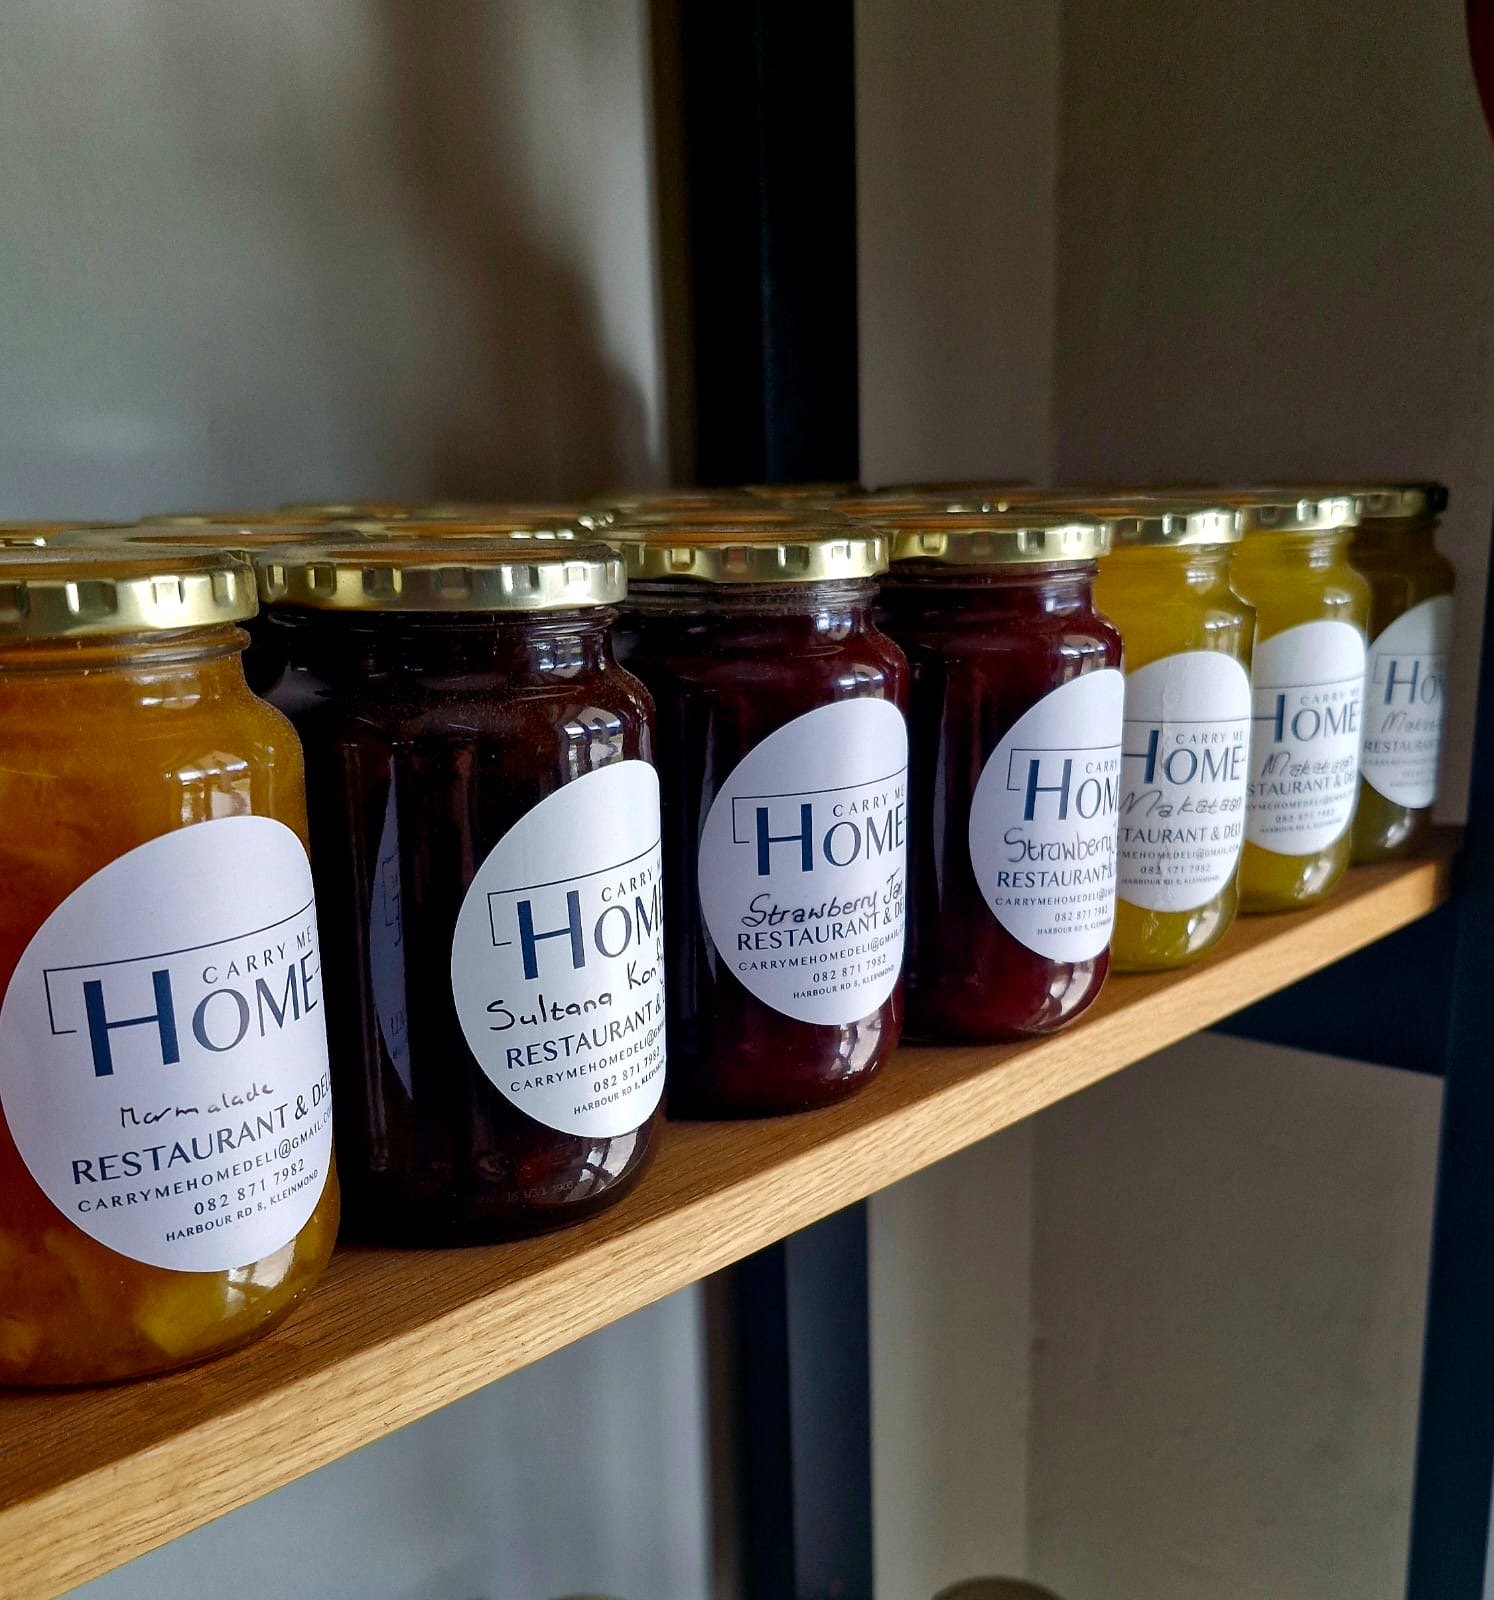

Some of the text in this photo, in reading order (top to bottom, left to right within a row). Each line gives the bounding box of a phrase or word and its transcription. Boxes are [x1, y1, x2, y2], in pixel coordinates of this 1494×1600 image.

[1300, 692, 1345, 706] CARRY
[1175, 730, 1244, 745] CARRY ME
[832, 793, 888, 818] CARRY
[1023, 759, 1119, 821] HOM
[1247, 776, 1329, 797] STAURANT
[756, 802, 905, 876] HOME
[1003, 827, 1112, 867] Strawberry
[1118, 827, 1207, 844] TAURANT
[1210, 826, 1220, 841] &
[601, 865, 653, 902] CARRY
[997, 864, 1107, 888] RESTAURANT
[737, 912, 880, 950] RESTAURANT
[883, 906, 892, 925] &
[741, 891, 878, 927] Strawberry
[1054, 911, 1073, 923] 082
[1076, 909, 1091, 921] 871
[1037, 926, 1073, 936] HARBOUR
[202, 925, 312, 984] CARRY ME
[812, 953, 886, 983] 082 871 7982
[793, 985, 837, 999] HARBOUR
[840, 982, 851, 991] RD
[82, 950, 319, 1078] HOME
[486, 992, 612, 1031] Sultana
[506, 1000, 653, 1069] RESTAURANT
[593, 1046, 660, 1093] 082 871 7982
[120, 1082, 274, 1128] Marmalade
[573, 1092, 620, 1115] HARBOUR
[621, 1086, 632, 1098] RD
[71, 1103, 289, 1185] RESTAURANT
[294, 1094, 309, 1120] &
[165, 1168, 319, 1242] HARBOUR RD 8, KLEINMOND
[194, 1158, 305, 1216] 082 871 7982
